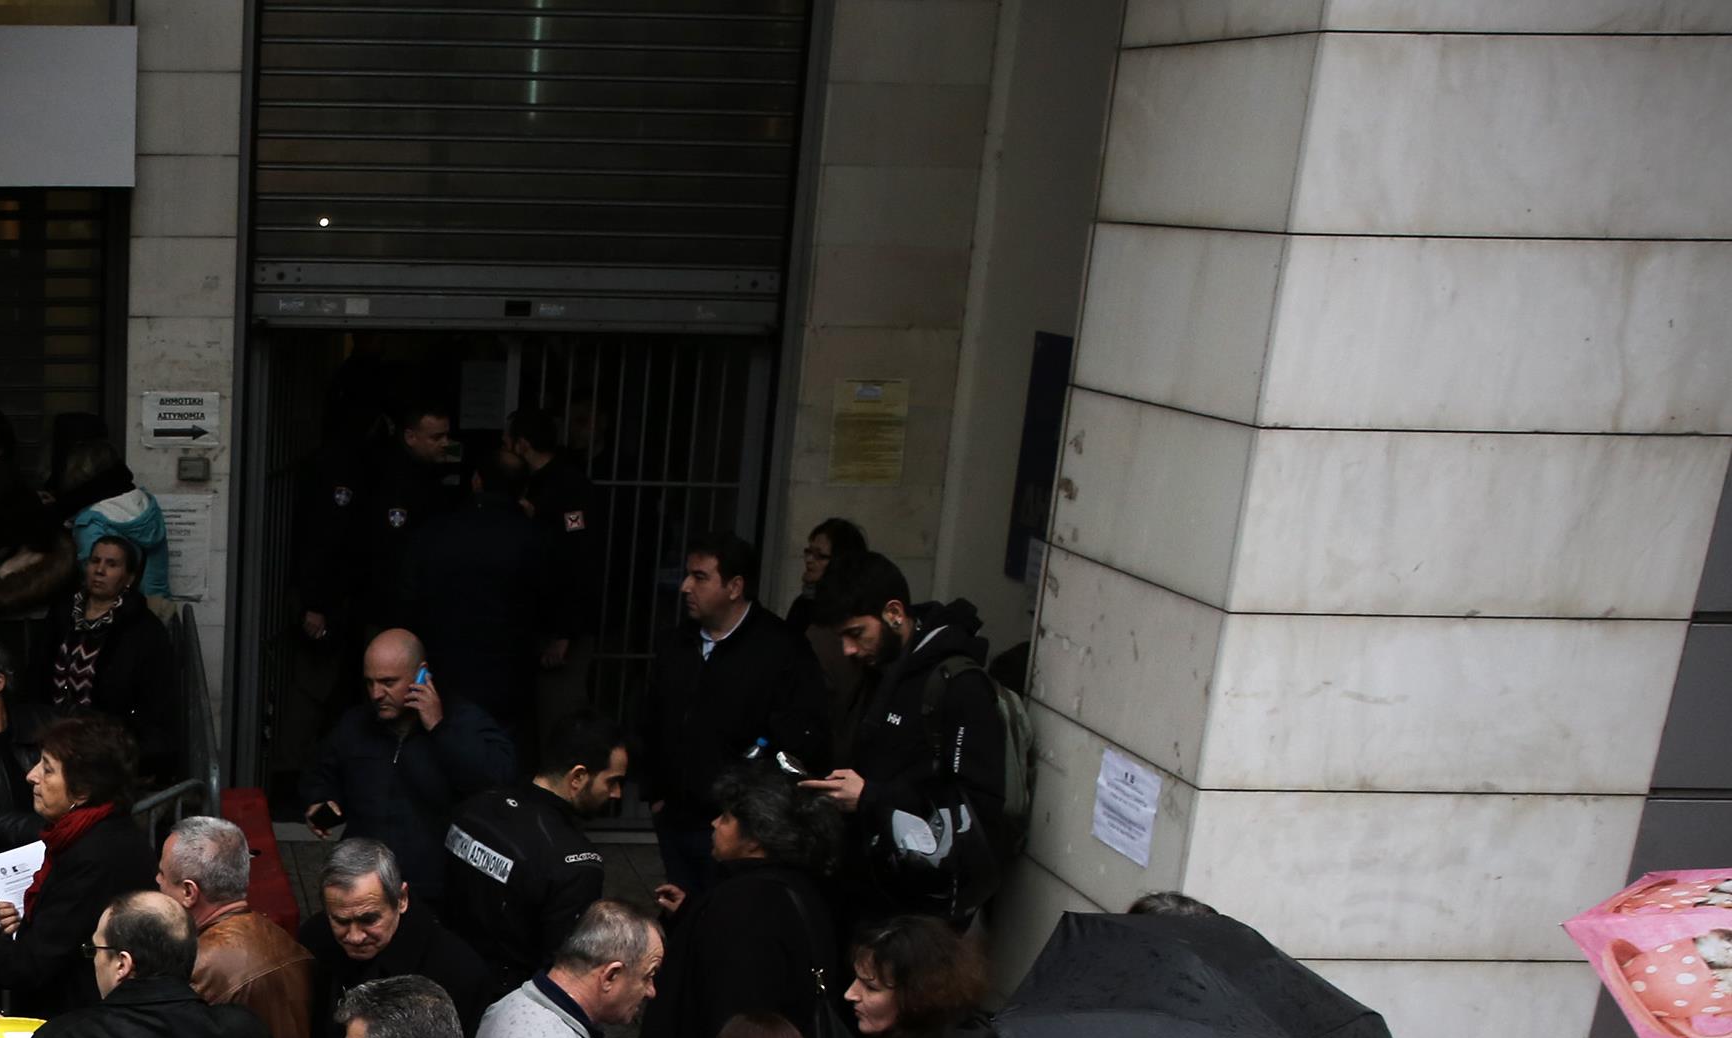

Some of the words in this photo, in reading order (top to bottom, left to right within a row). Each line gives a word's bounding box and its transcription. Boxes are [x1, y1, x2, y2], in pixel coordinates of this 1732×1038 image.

[159, 397, 204, 406] ΔΗΜΟΤΙΚΗ
[157, 412, 206, 420] ΑΣΤΥΝΟΜΙΑ
[886, 712, 902, 726] HH
